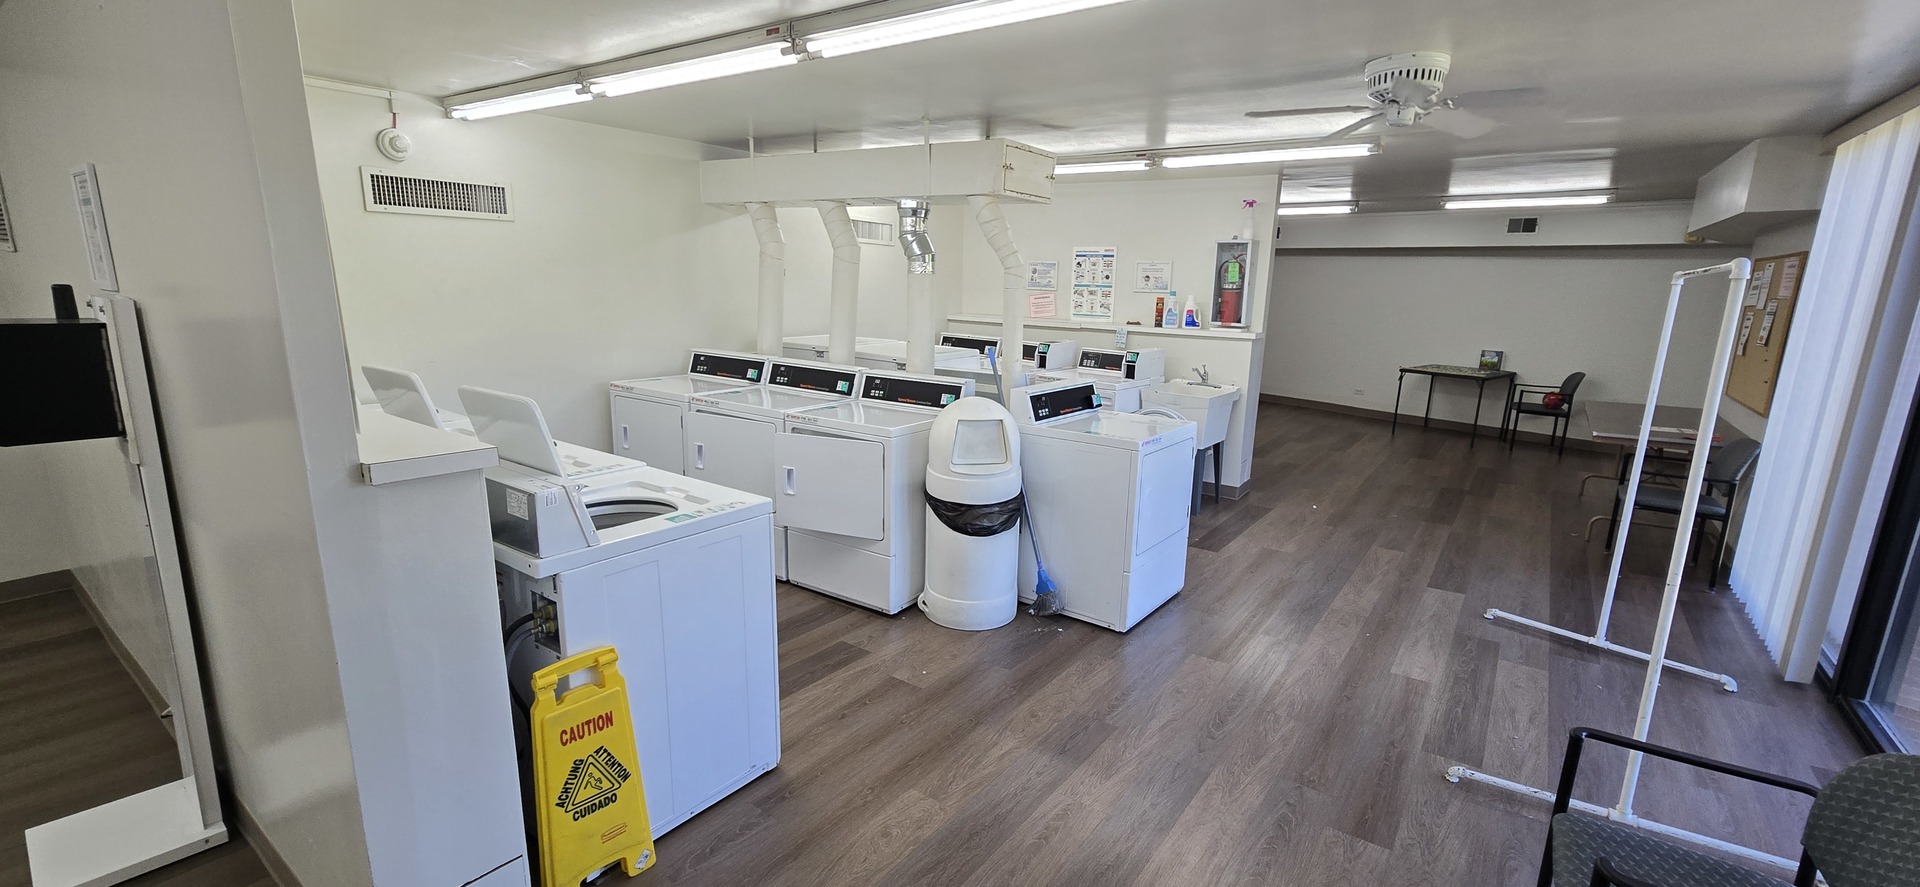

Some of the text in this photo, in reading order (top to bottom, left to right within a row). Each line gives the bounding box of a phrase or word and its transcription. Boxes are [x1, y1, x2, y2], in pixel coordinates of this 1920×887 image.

[560, 711, 614, 747] CAUTION
[593, 745, 632, 783] ATTENTION
[555, 759, 584, 809] ACHTUNG
[572, 793, 618, 822] CUIDADO
